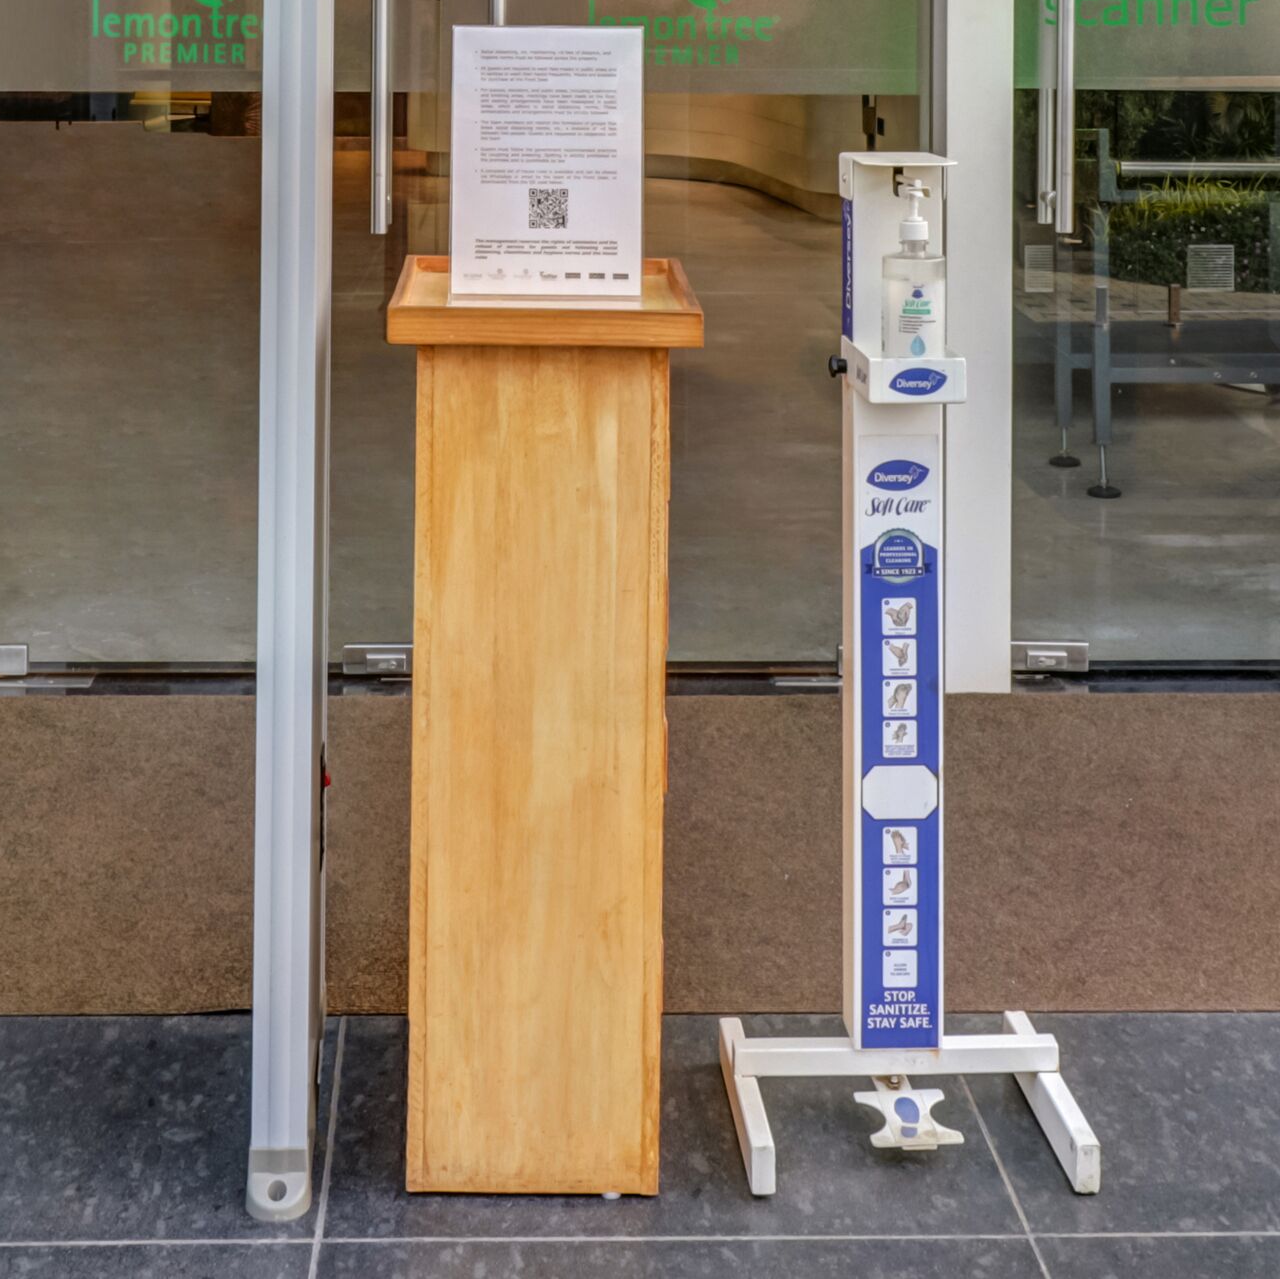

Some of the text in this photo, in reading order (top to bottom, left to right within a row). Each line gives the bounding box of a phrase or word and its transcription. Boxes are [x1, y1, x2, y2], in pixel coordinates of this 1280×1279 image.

[208, 6, 264, 40] tre
[705, 12, 775, 42] tree
[123, 42, 246, 65] PREMIER
[896, 378, 932, 391] Diversey
[874, 472, 913, 485] Diversey
[865, 497, 894, 517] Soft
[884, 990, 916, 1002] STOP.
[869, 1003, 931, 1016] SANITIZE.
[867, 1016, 933, 1029] STAY SAFE.
